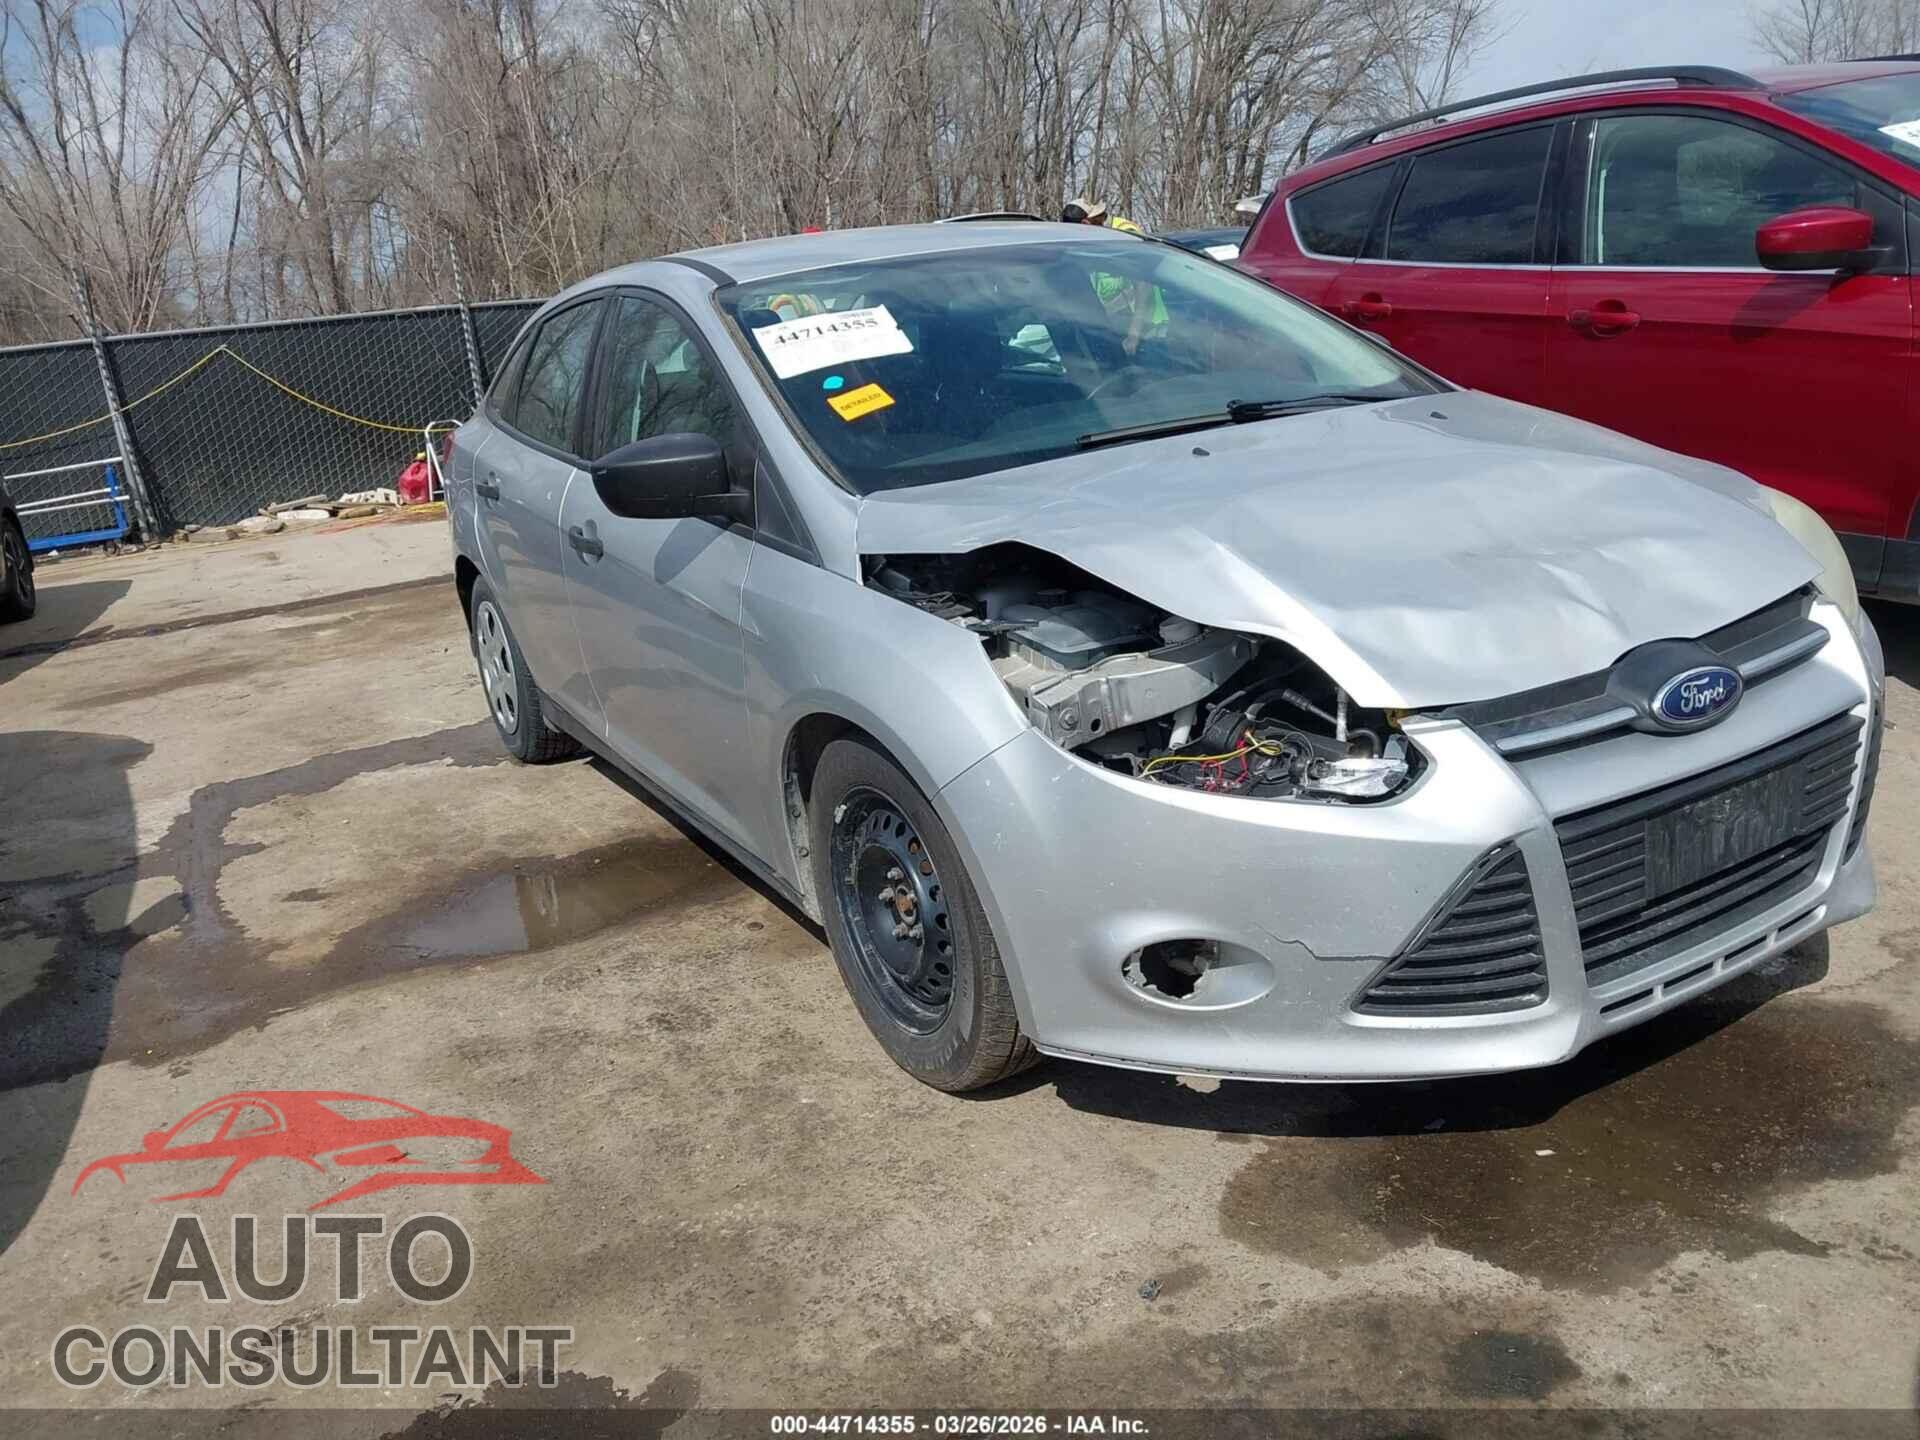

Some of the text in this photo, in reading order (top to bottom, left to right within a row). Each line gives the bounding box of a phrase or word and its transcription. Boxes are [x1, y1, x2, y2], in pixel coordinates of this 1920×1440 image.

[775, 319, 878, 345] 44714355
[840, 392, 881, 411] DETAILED
[1680, 677, 1727, 713] Ford
